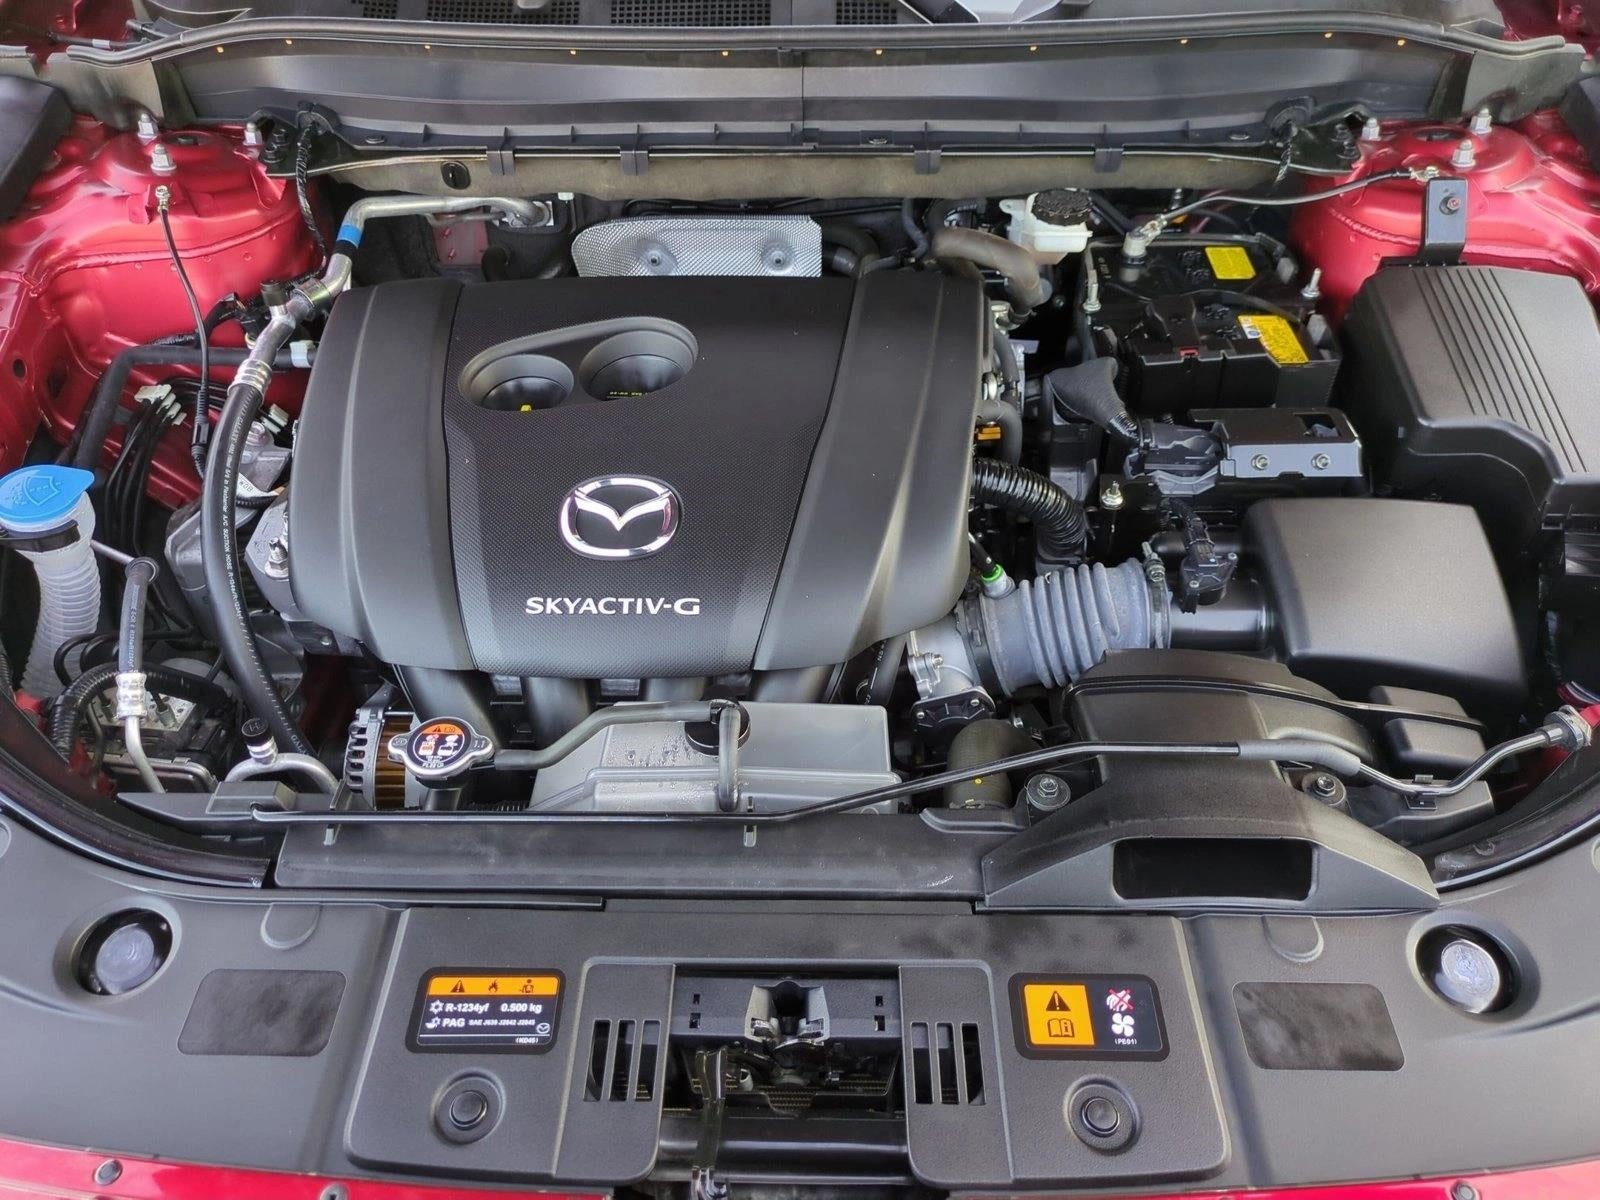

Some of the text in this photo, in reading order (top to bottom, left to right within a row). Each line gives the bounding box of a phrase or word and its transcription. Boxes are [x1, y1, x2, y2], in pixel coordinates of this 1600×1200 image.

[223, 528, 231, 552] SUCTION
[225, 553, 233, 569] HOSE
[525, 597, 700, 615] SKYACTIV-G
[445, 1002, 543, 1014] R-1234yf 0.500 kg
[442, 1017, 466, 1027] PAG
